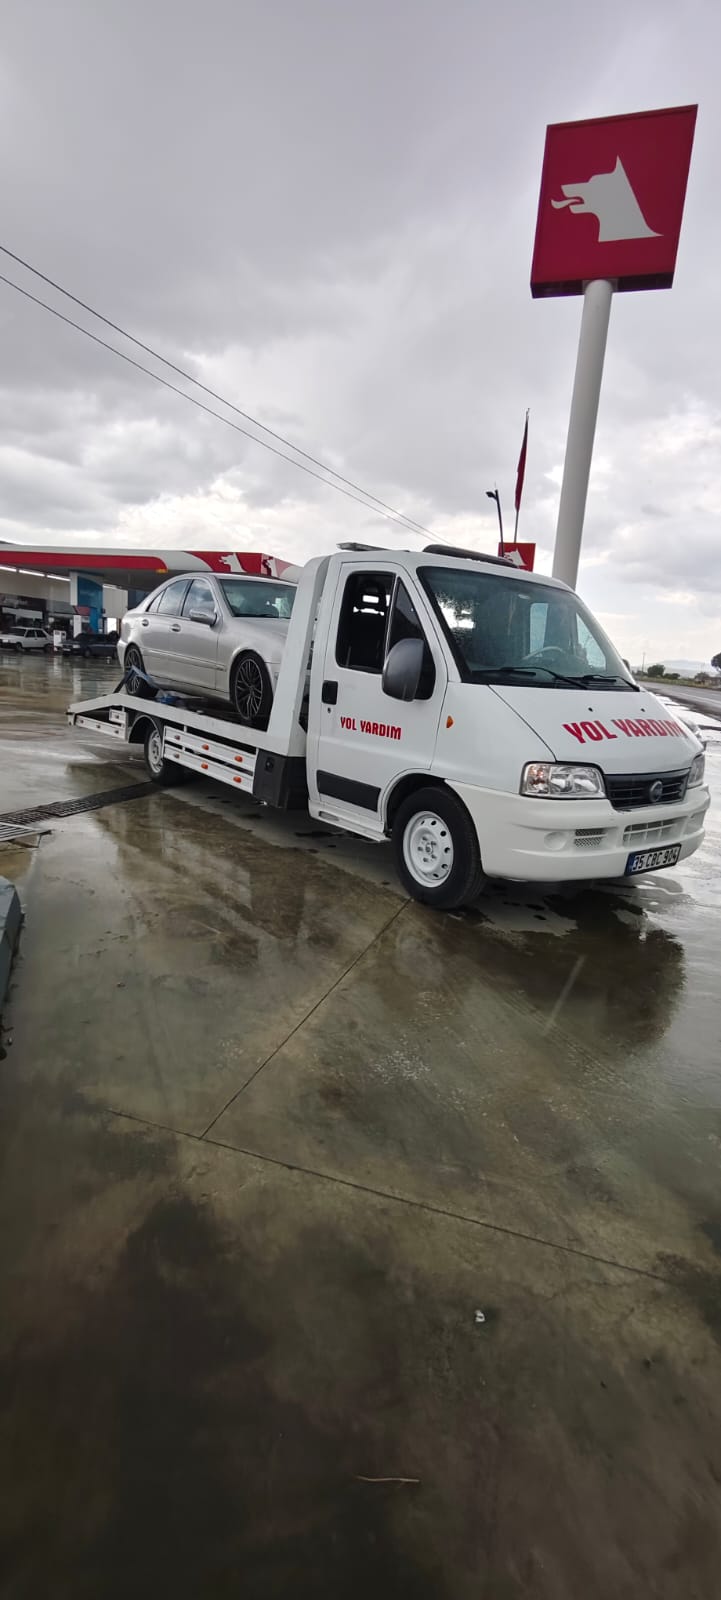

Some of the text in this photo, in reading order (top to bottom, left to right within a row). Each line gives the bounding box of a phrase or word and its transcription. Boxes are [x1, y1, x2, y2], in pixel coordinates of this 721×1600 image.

[340, 716, 402, 740] YOL YARDIM
[562, 719, 688, 743] YOL YARDIM
[632, 854, 645, 870] 35
